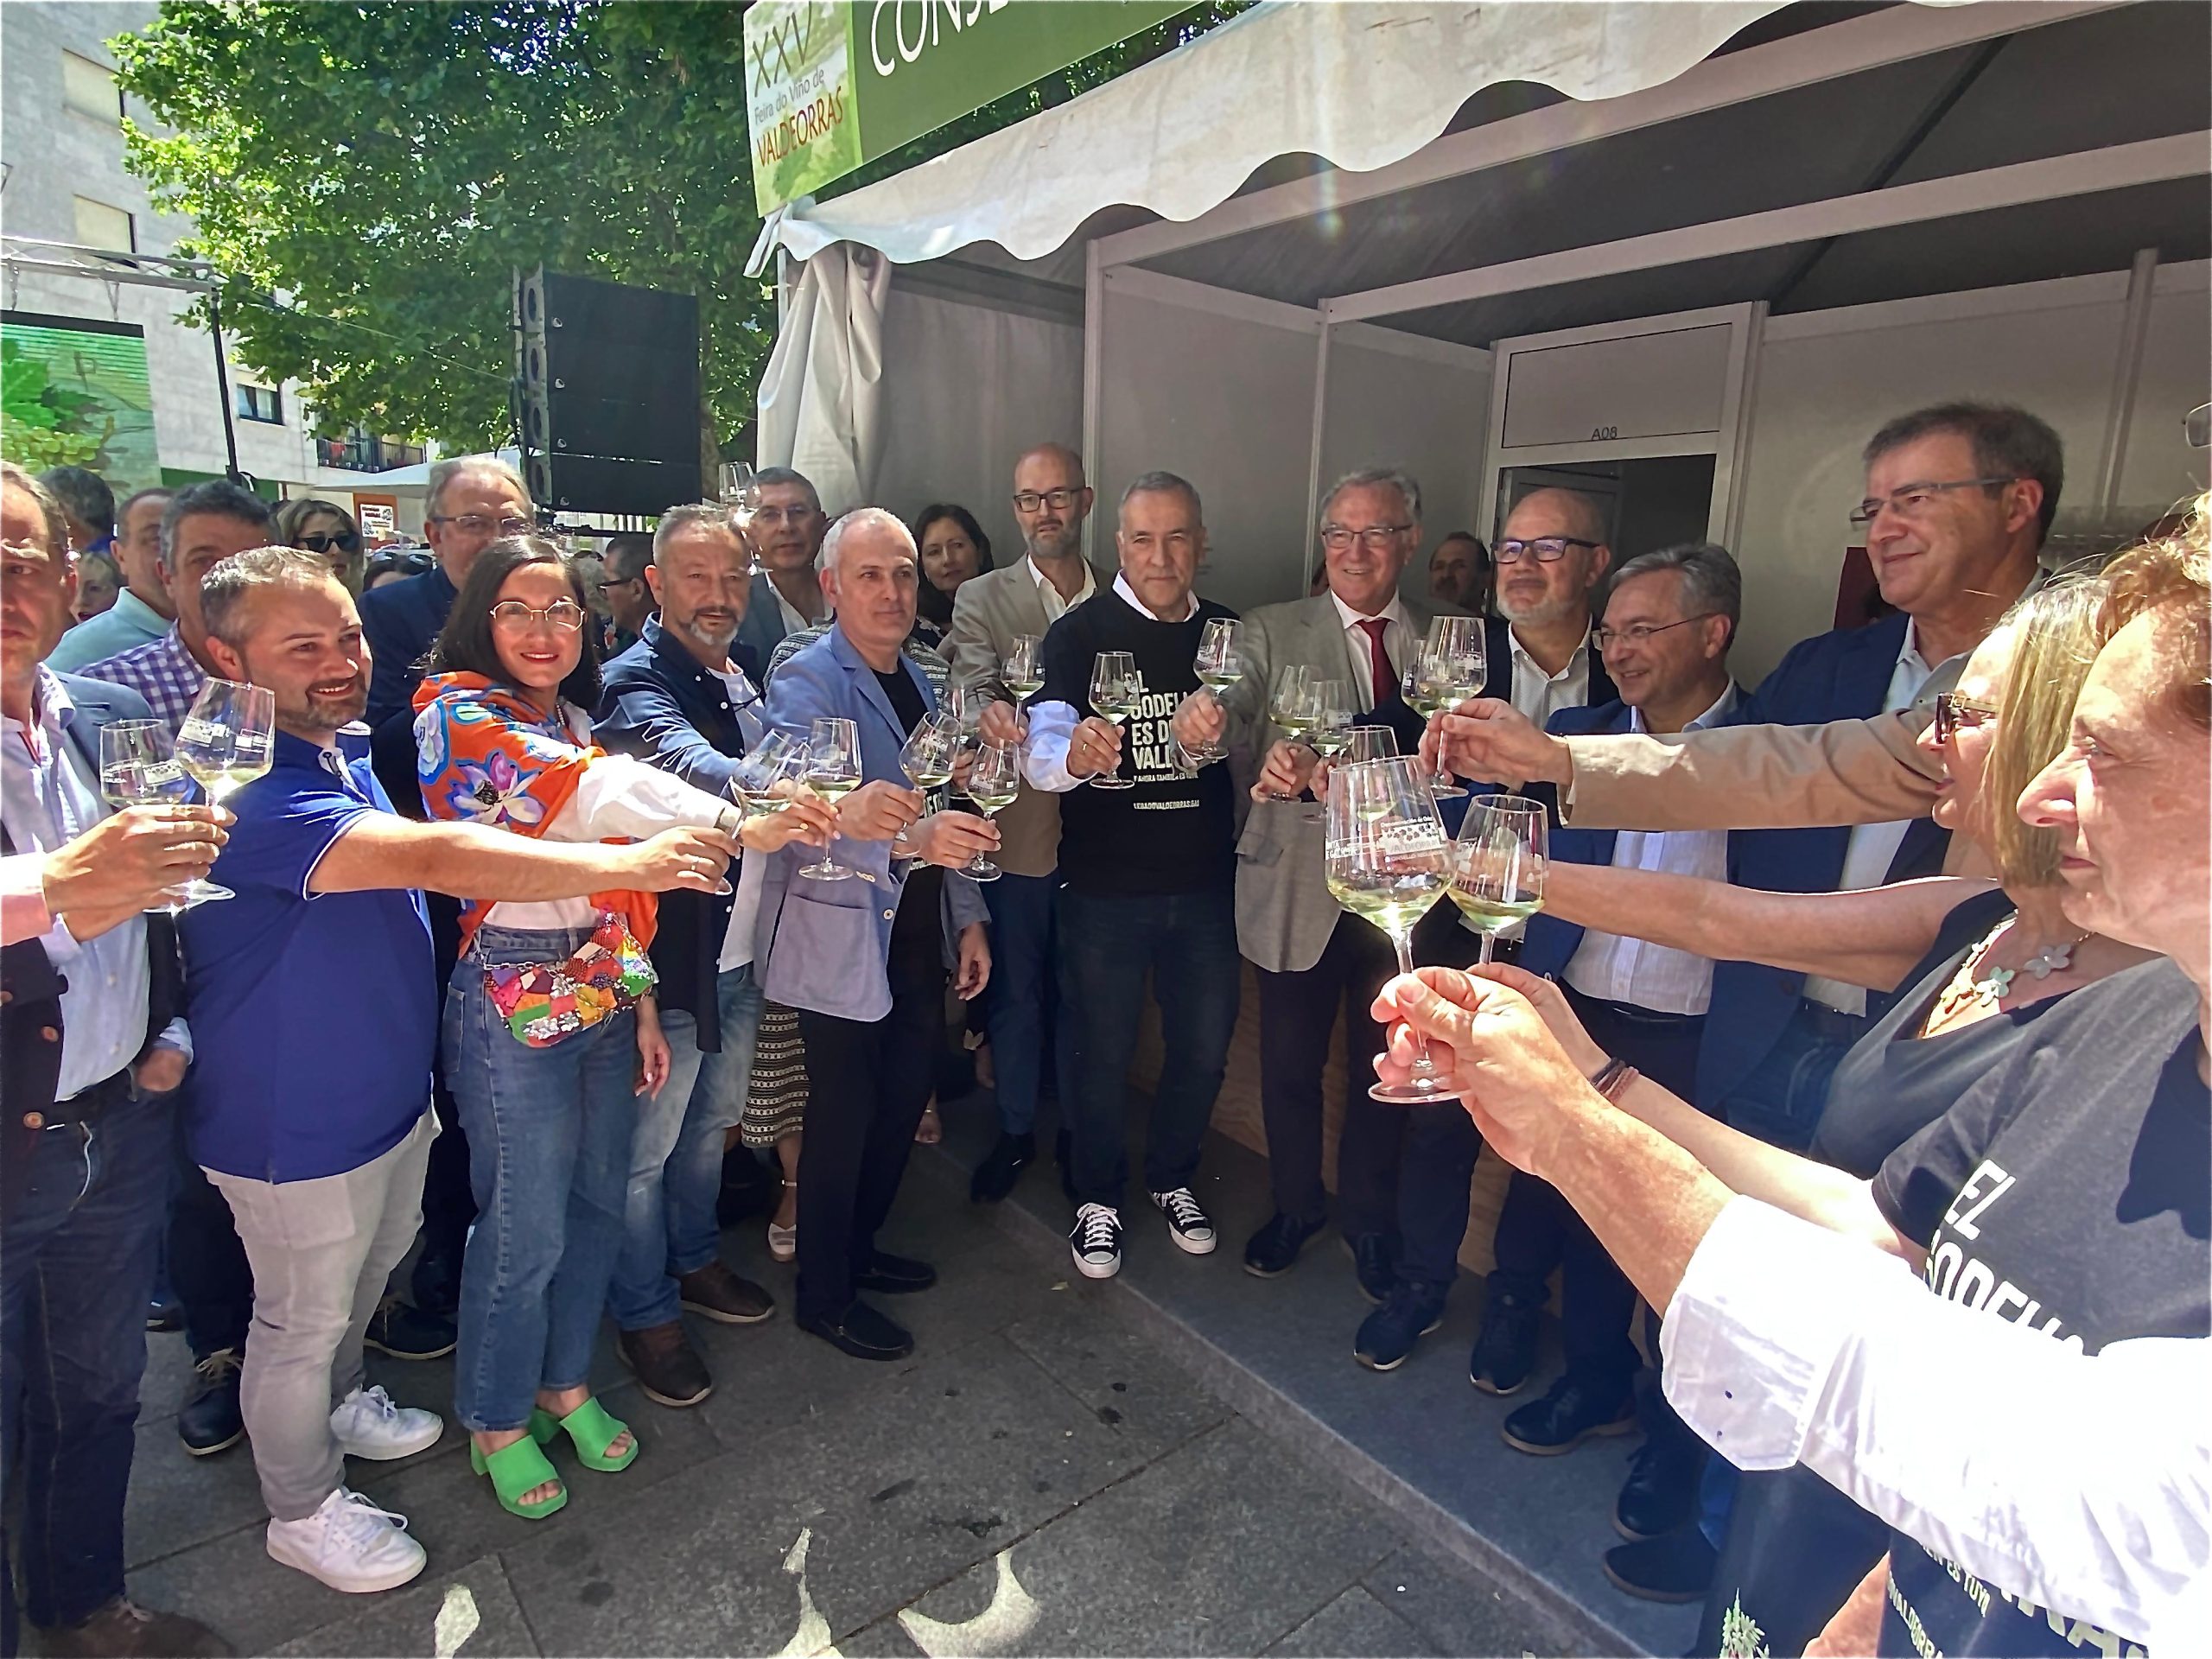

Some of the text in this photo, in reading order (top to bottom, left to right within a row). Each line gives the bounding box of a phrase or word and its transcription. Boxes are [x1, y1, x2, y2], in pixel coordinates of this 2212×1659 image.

[752, 0, 812, 99] XXV
[754, 102, 774, 125] Feira
[777, 92, 787, 112] do
[812, 67, 824, 88] de
[756, 85, 843, 168] VALDEORRAS
[1591, 426, 1618, 441] A08
[1132, 719, 1172, 746] ES D
[1944, 1159, 2016, 1241] EL
